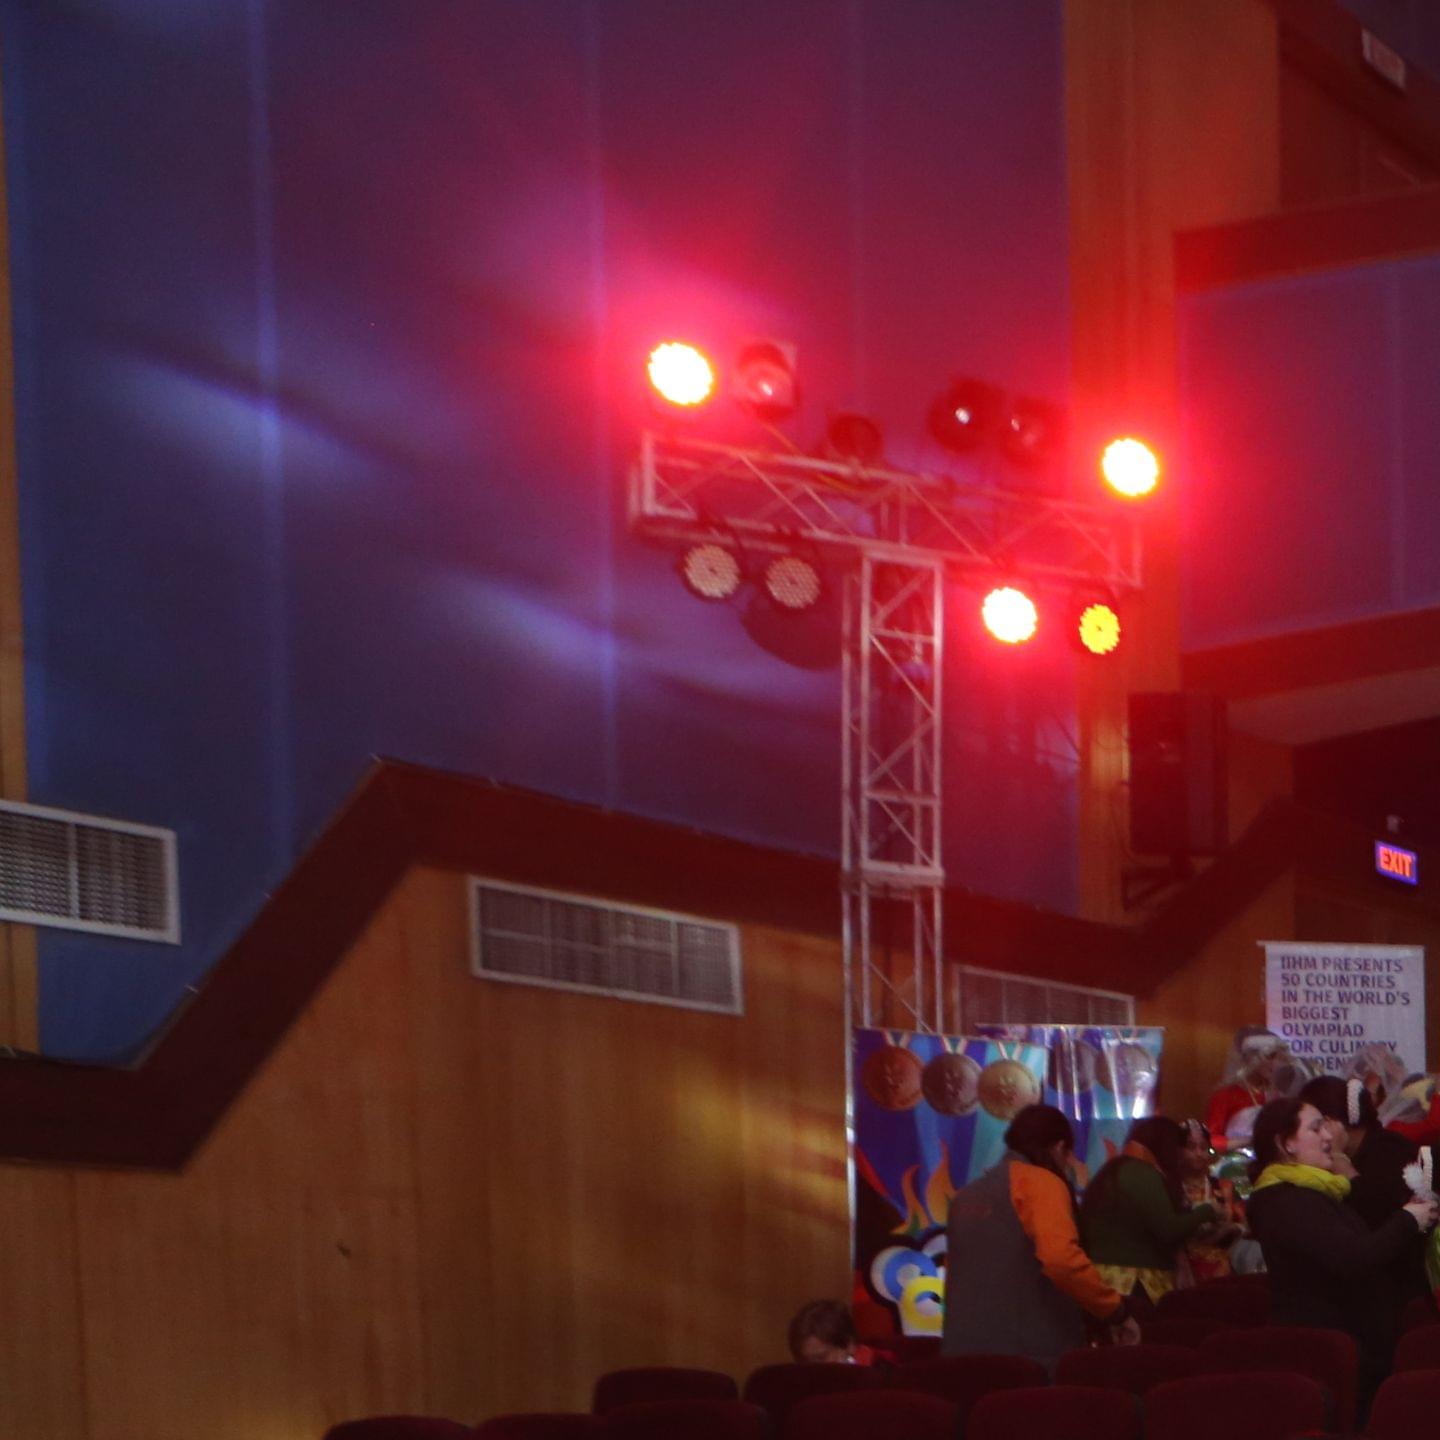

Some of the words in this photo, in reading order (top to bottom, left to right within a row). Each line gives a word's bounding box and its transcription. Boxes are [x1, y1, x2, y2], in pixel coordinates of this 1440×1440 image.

[1379, 846, 1413, 878] EXIT
[1281, 955, 1317, 970] IIHM
[1322, 957, 1403, 972] PRESENTS
[1281, 973, 1301, 986] 50
[1305, 974, 1396, 989] COUNTRIES
[1282, 990, 1298, 1003] IN
[1304, 991, 1333, 1004] THE
[1338, 991, 1411, 1006] WORLD'S
[1282, 1006, 1350, 1021] BIGGEST
[1282, 1023, 1364, 1037] OLYMPIAD
[1285, 1039, 1314, 1053] OR
